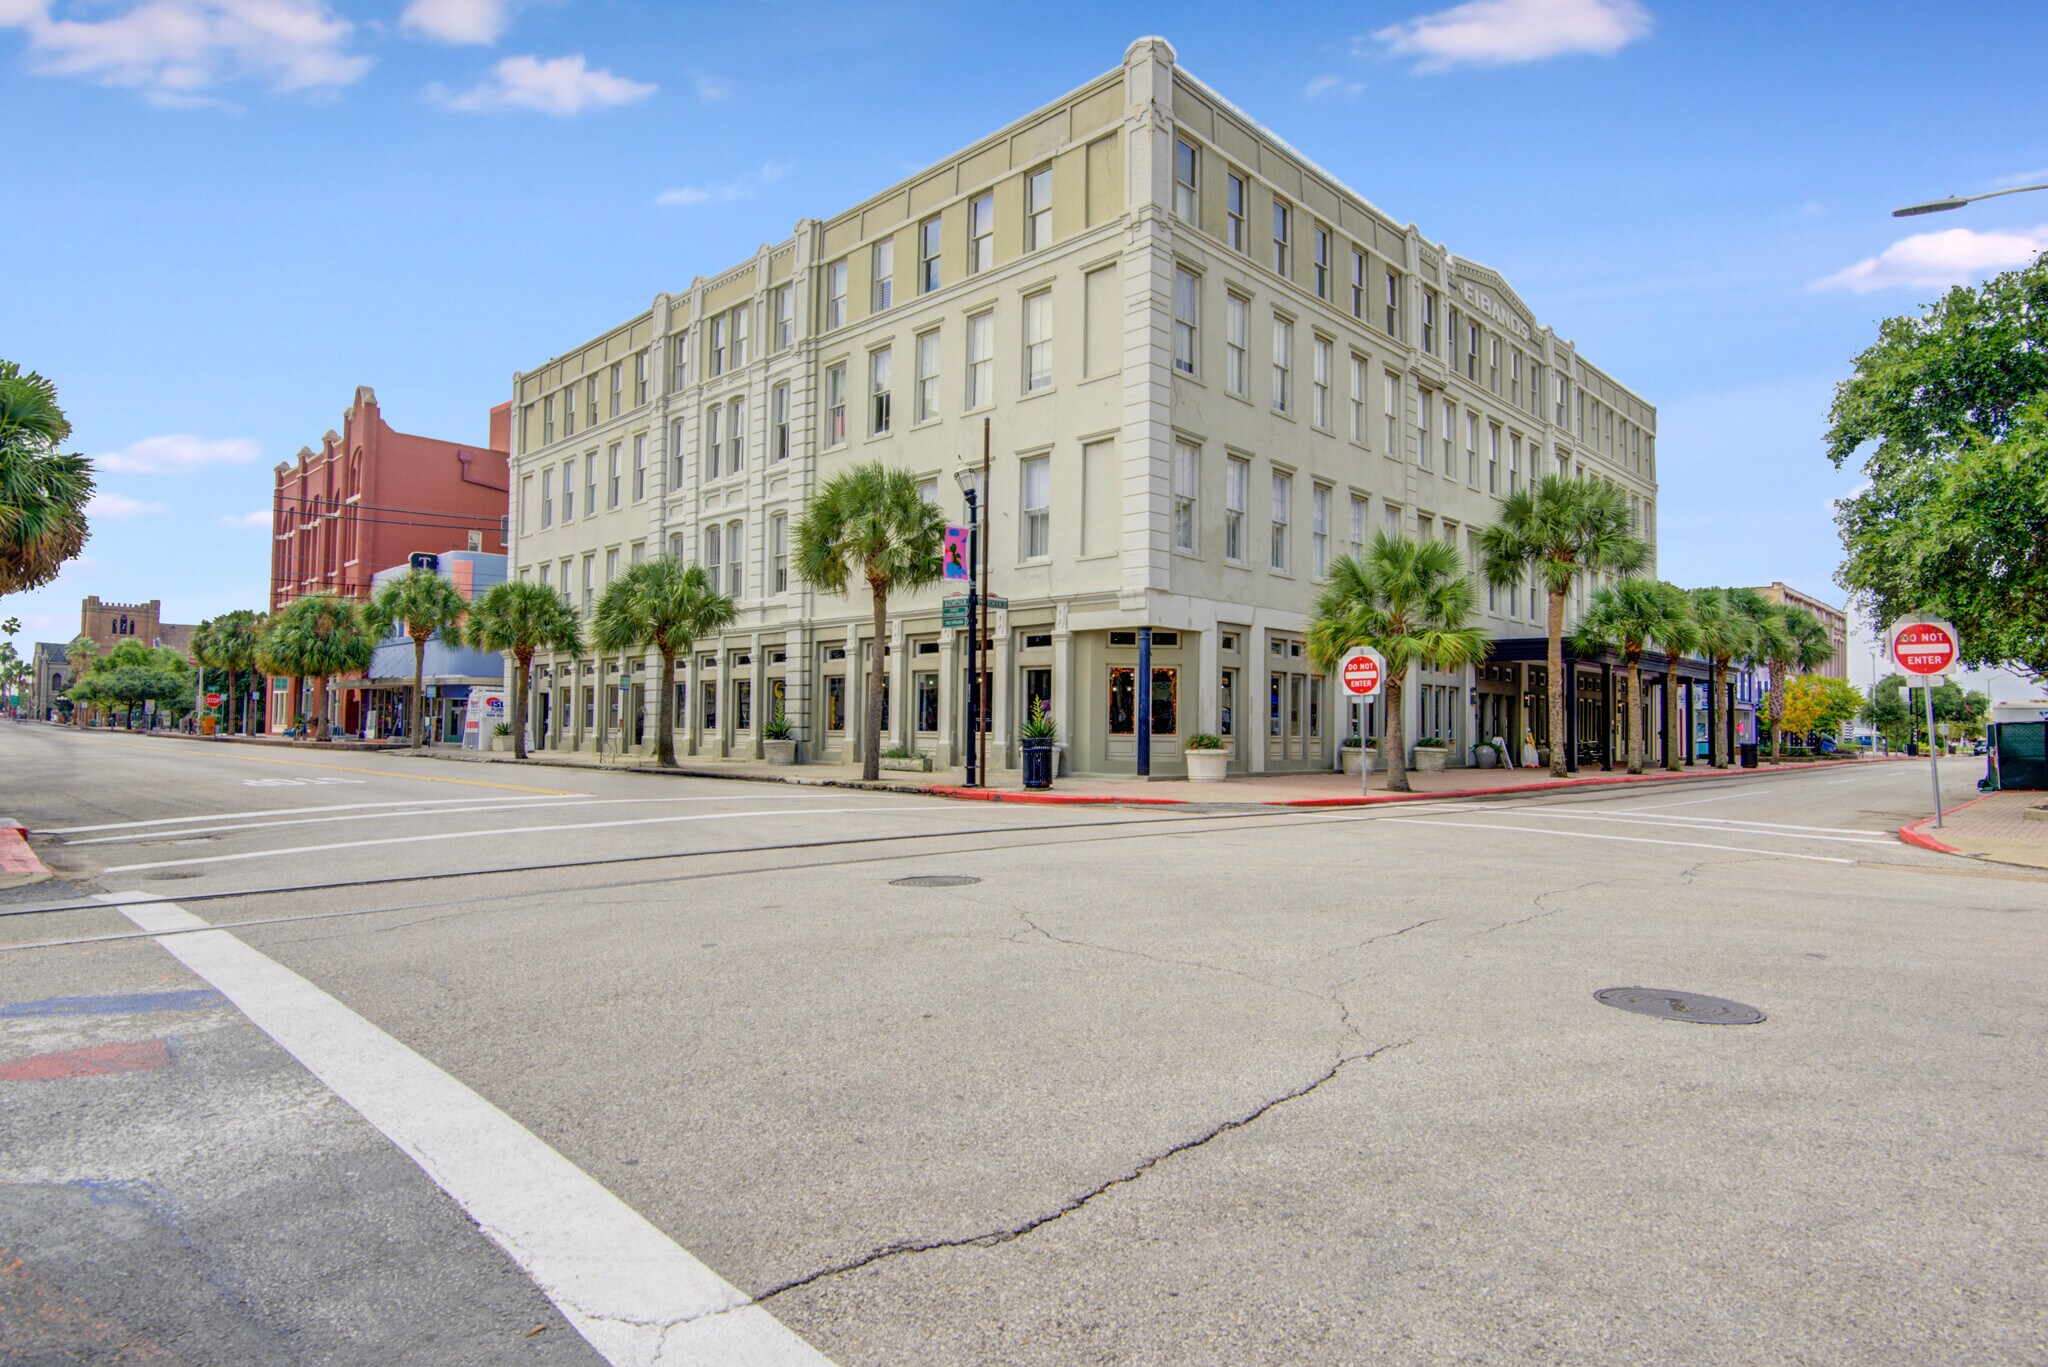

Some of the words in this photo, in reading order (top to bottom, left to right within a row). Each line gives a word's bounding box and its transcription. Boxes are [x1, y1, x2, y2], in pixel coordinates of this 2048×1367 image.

[1463, 281, 1529, 341] EIBANDS
[1901, 634, 1917, 642] DO
[1921, 633, 1944, 642] NOT
[1908, 656, 1943, 664] ENTER
